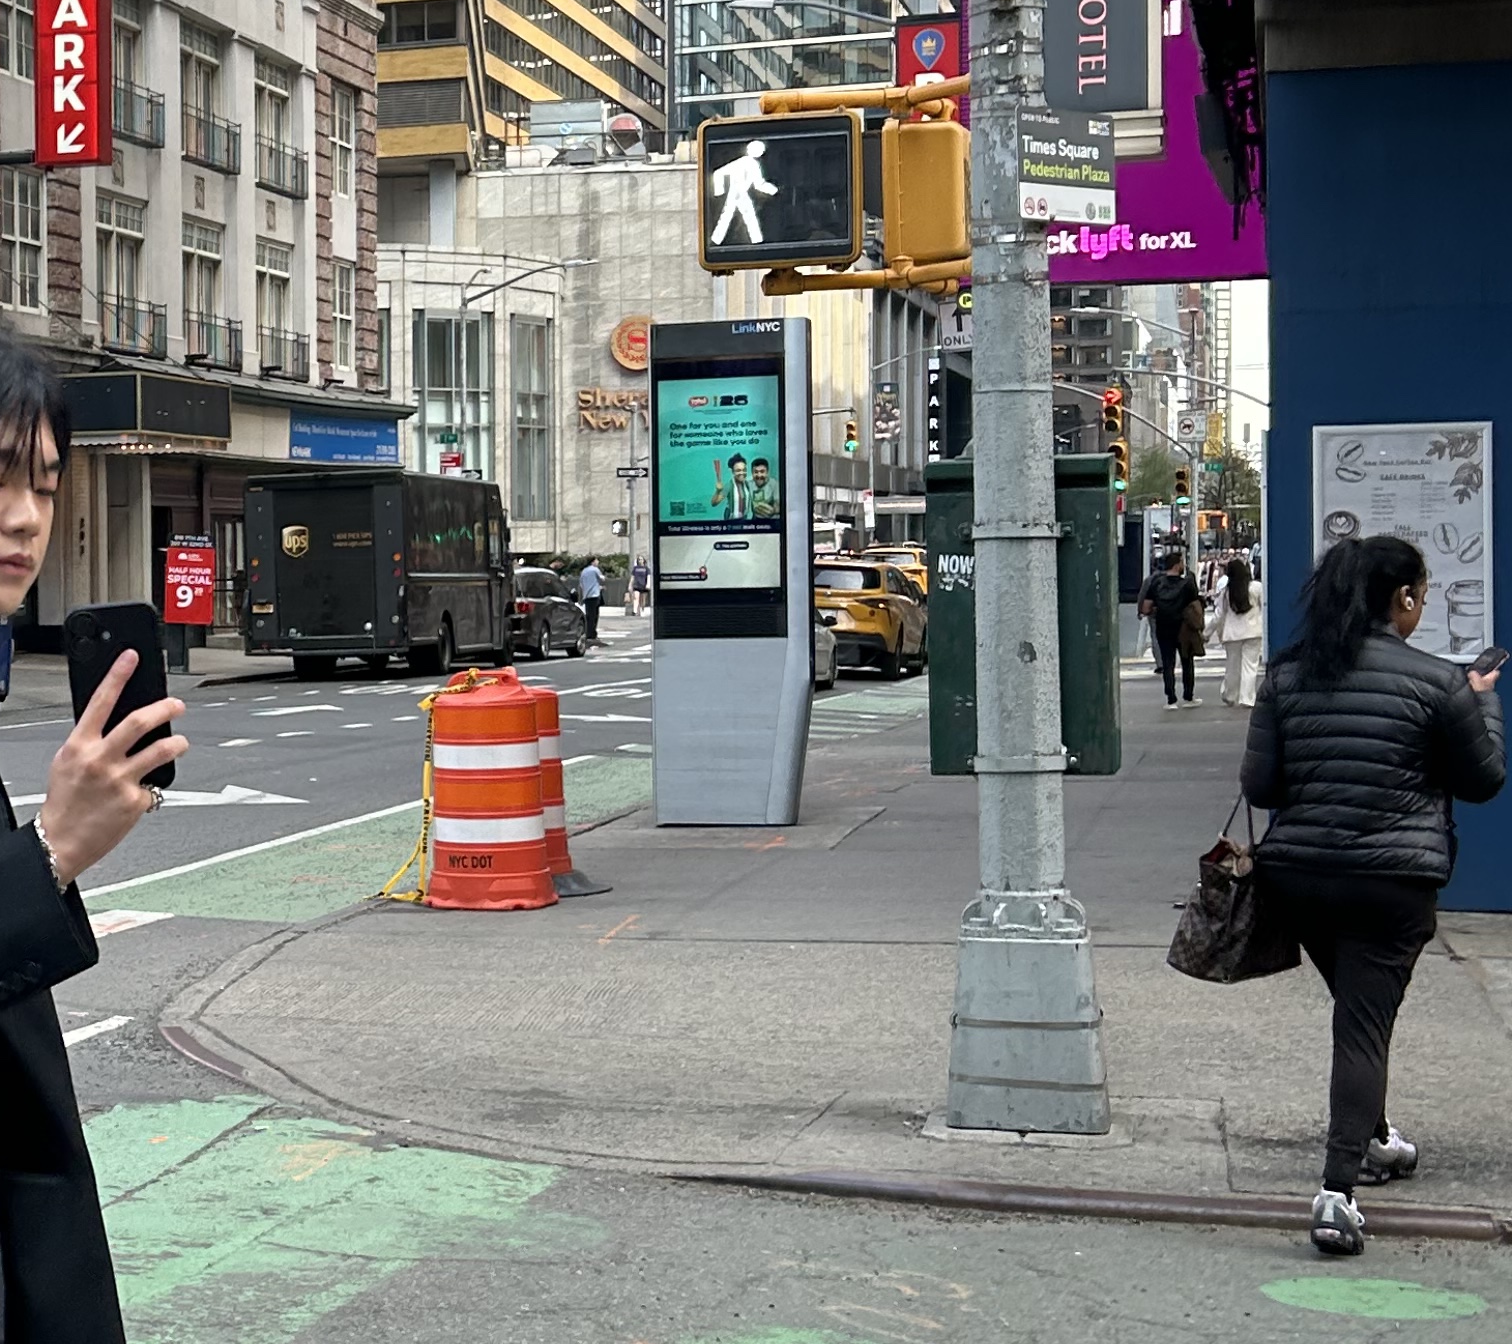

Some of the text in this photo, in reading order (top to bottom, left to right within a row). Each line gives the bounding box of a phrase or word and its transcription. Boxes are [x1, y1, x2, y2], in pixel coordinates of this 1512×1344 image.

[1022, 135, 1100, 161] Times Square
[1023, 158, 1111, 182] Pedestrian Plaza
[1047, 224, 1198, 260] ck lyft for XL
[578, 388, 649, 409] Shera
[579, 410, 628, 430] New
[928, 373, 939, 451] PARK
[669, 422, 687, 430] One
[689, 421, 701, 430] for
[721, 420, 739, 428] and
[669, 431, 683, 439] for
[685, 440, 712, 448] game
[712, 438, 729, 446] like
[748, 437, 760, 445] do
[285, 534, 307, 553] ups
[168, 574, 212, 585] SPECIAL
[169, 566, 211, 575] HALF HOUR
[176, 585, 194, 608] 9
[422, 798, 431, 854] CAUTION
[448, 855, 494, 868] NYC DOT
